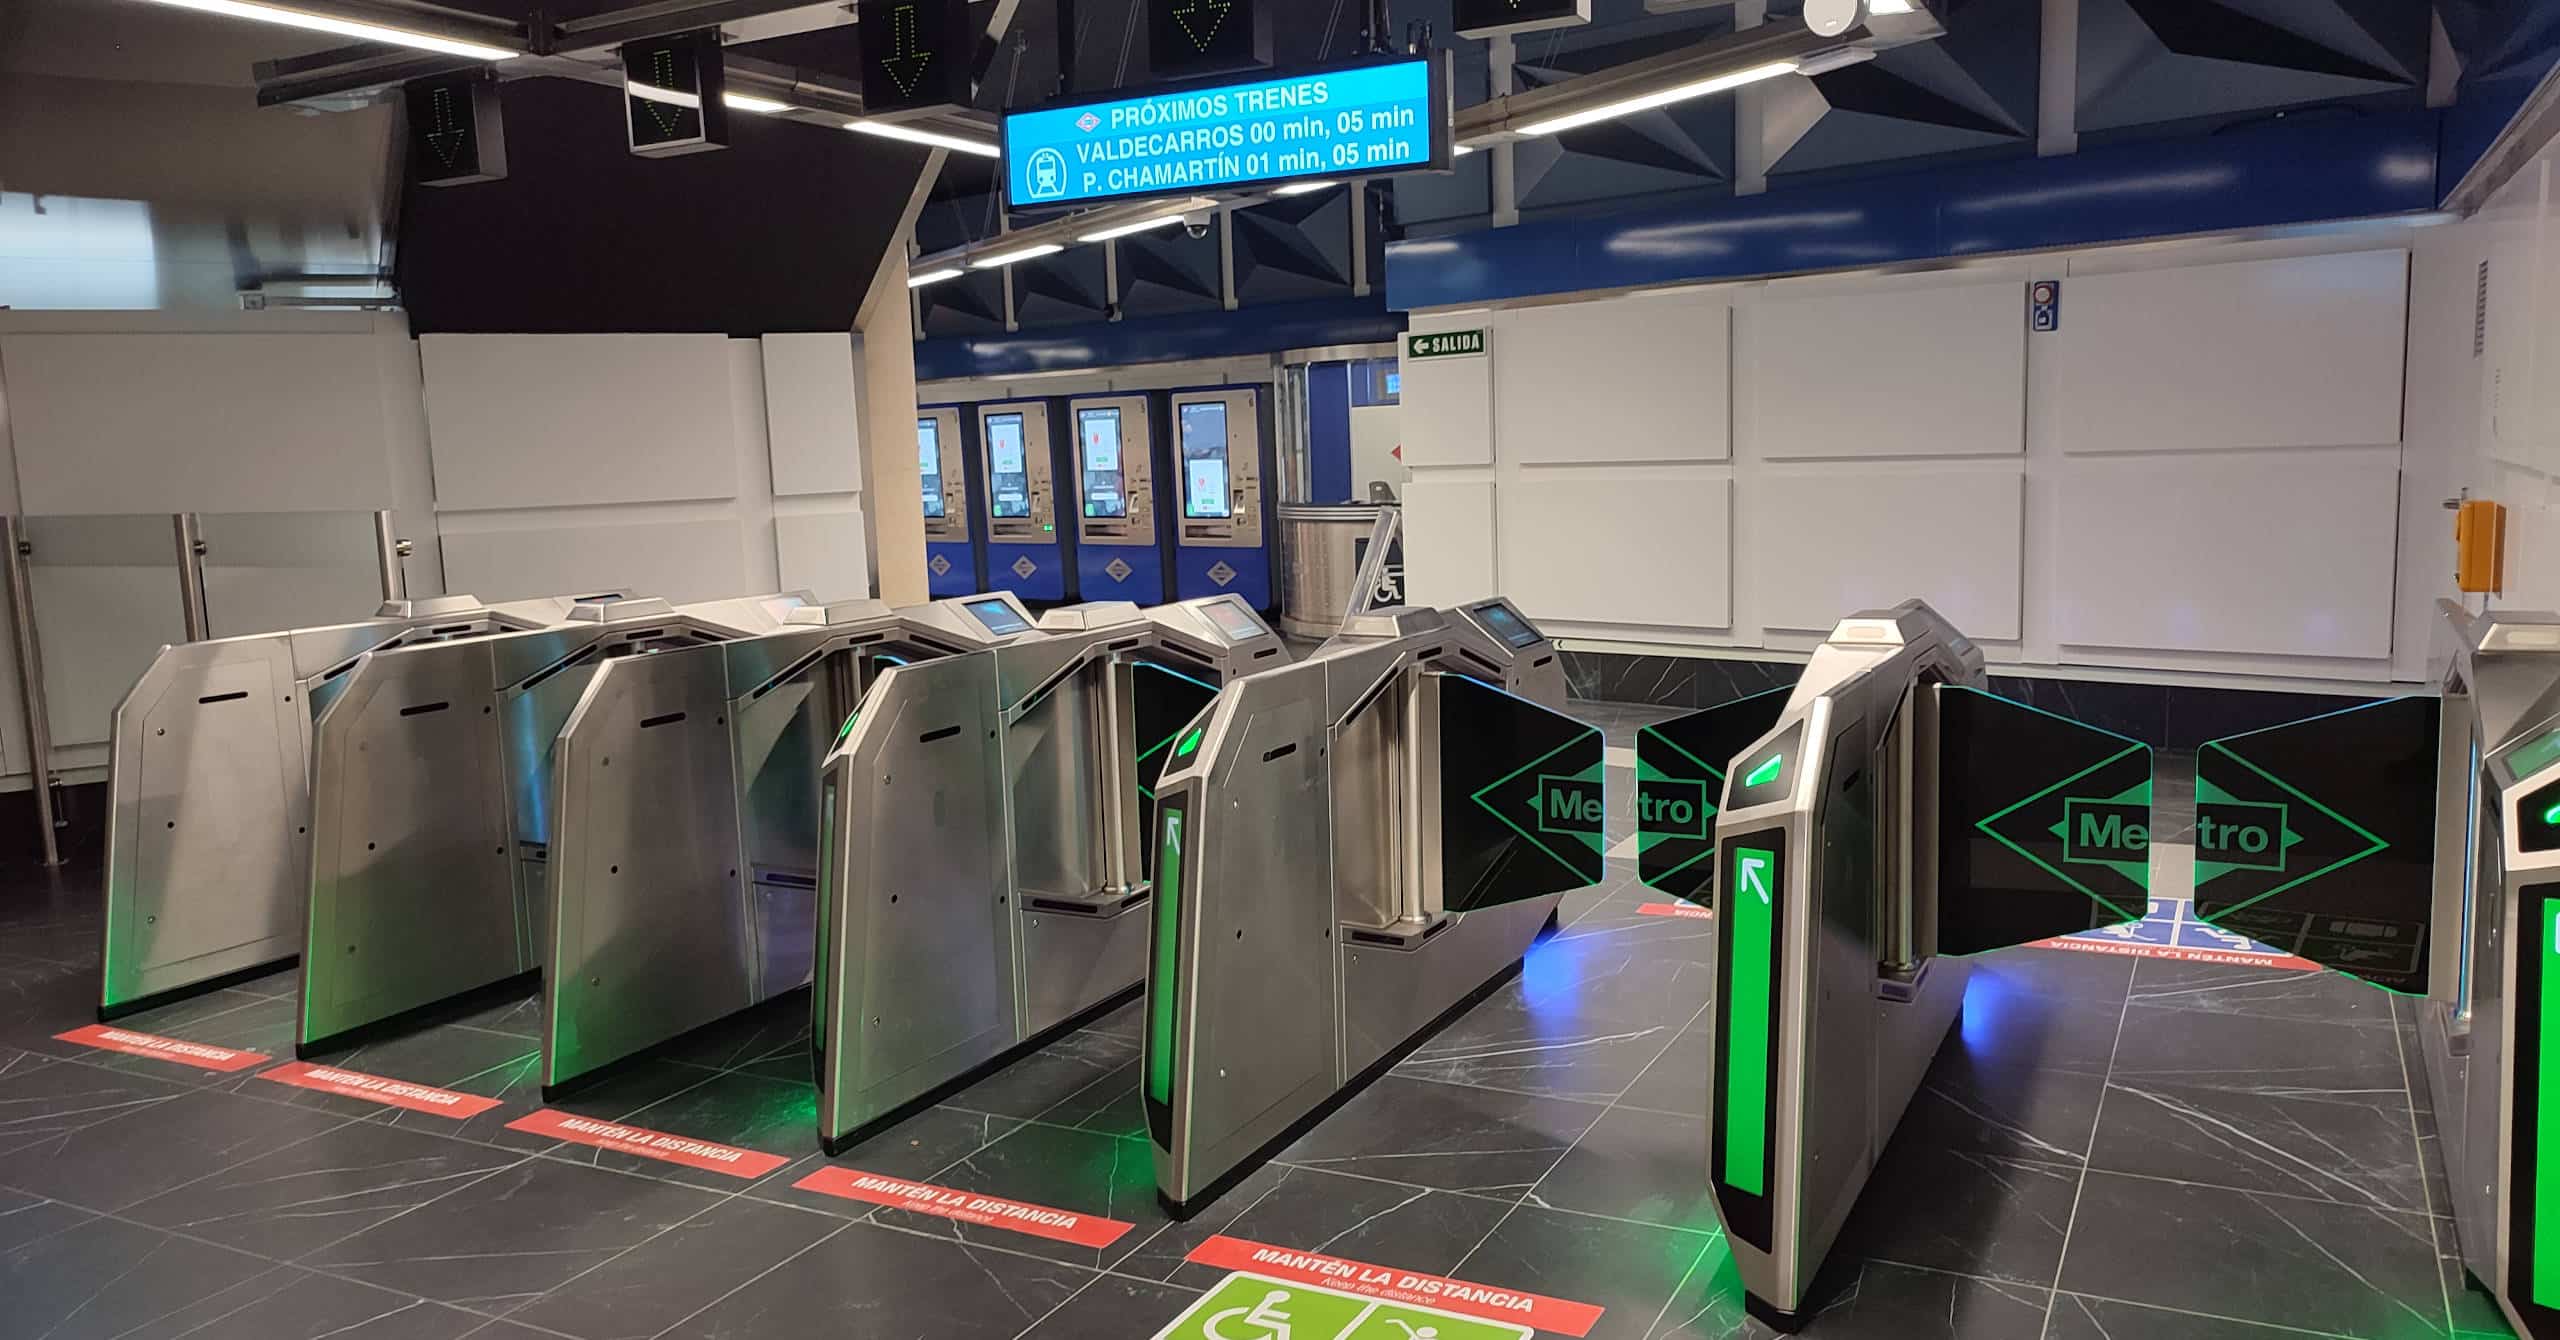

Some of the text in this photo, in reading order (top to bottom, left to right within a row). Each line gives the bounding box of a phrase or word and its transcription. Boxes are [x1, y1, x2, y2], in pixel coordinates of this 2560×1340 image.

[1111, 81, 1329, 129] PRÓXIMOS TRENES
[1076, 105, 1414, 164] VALDECARROS 00 min, 05 min
[1083, 137, 1410, 193] P. CHAMARTÍN 01 min, 05 min
[1432, 334, 1480, 353] SALIDA
[626, 1132, 655, 1144] LA
[650, 1137, 743, 1162] DISTANCIA
[851, 1176, 939, 1200] MANTÉN
[936, 1192, 967, 1207] LA
[966, 1199, 1078, 1229] DISTANCIA
[1252, 1248, 1534, 1313] MANTÉN LA DISTANCIA
